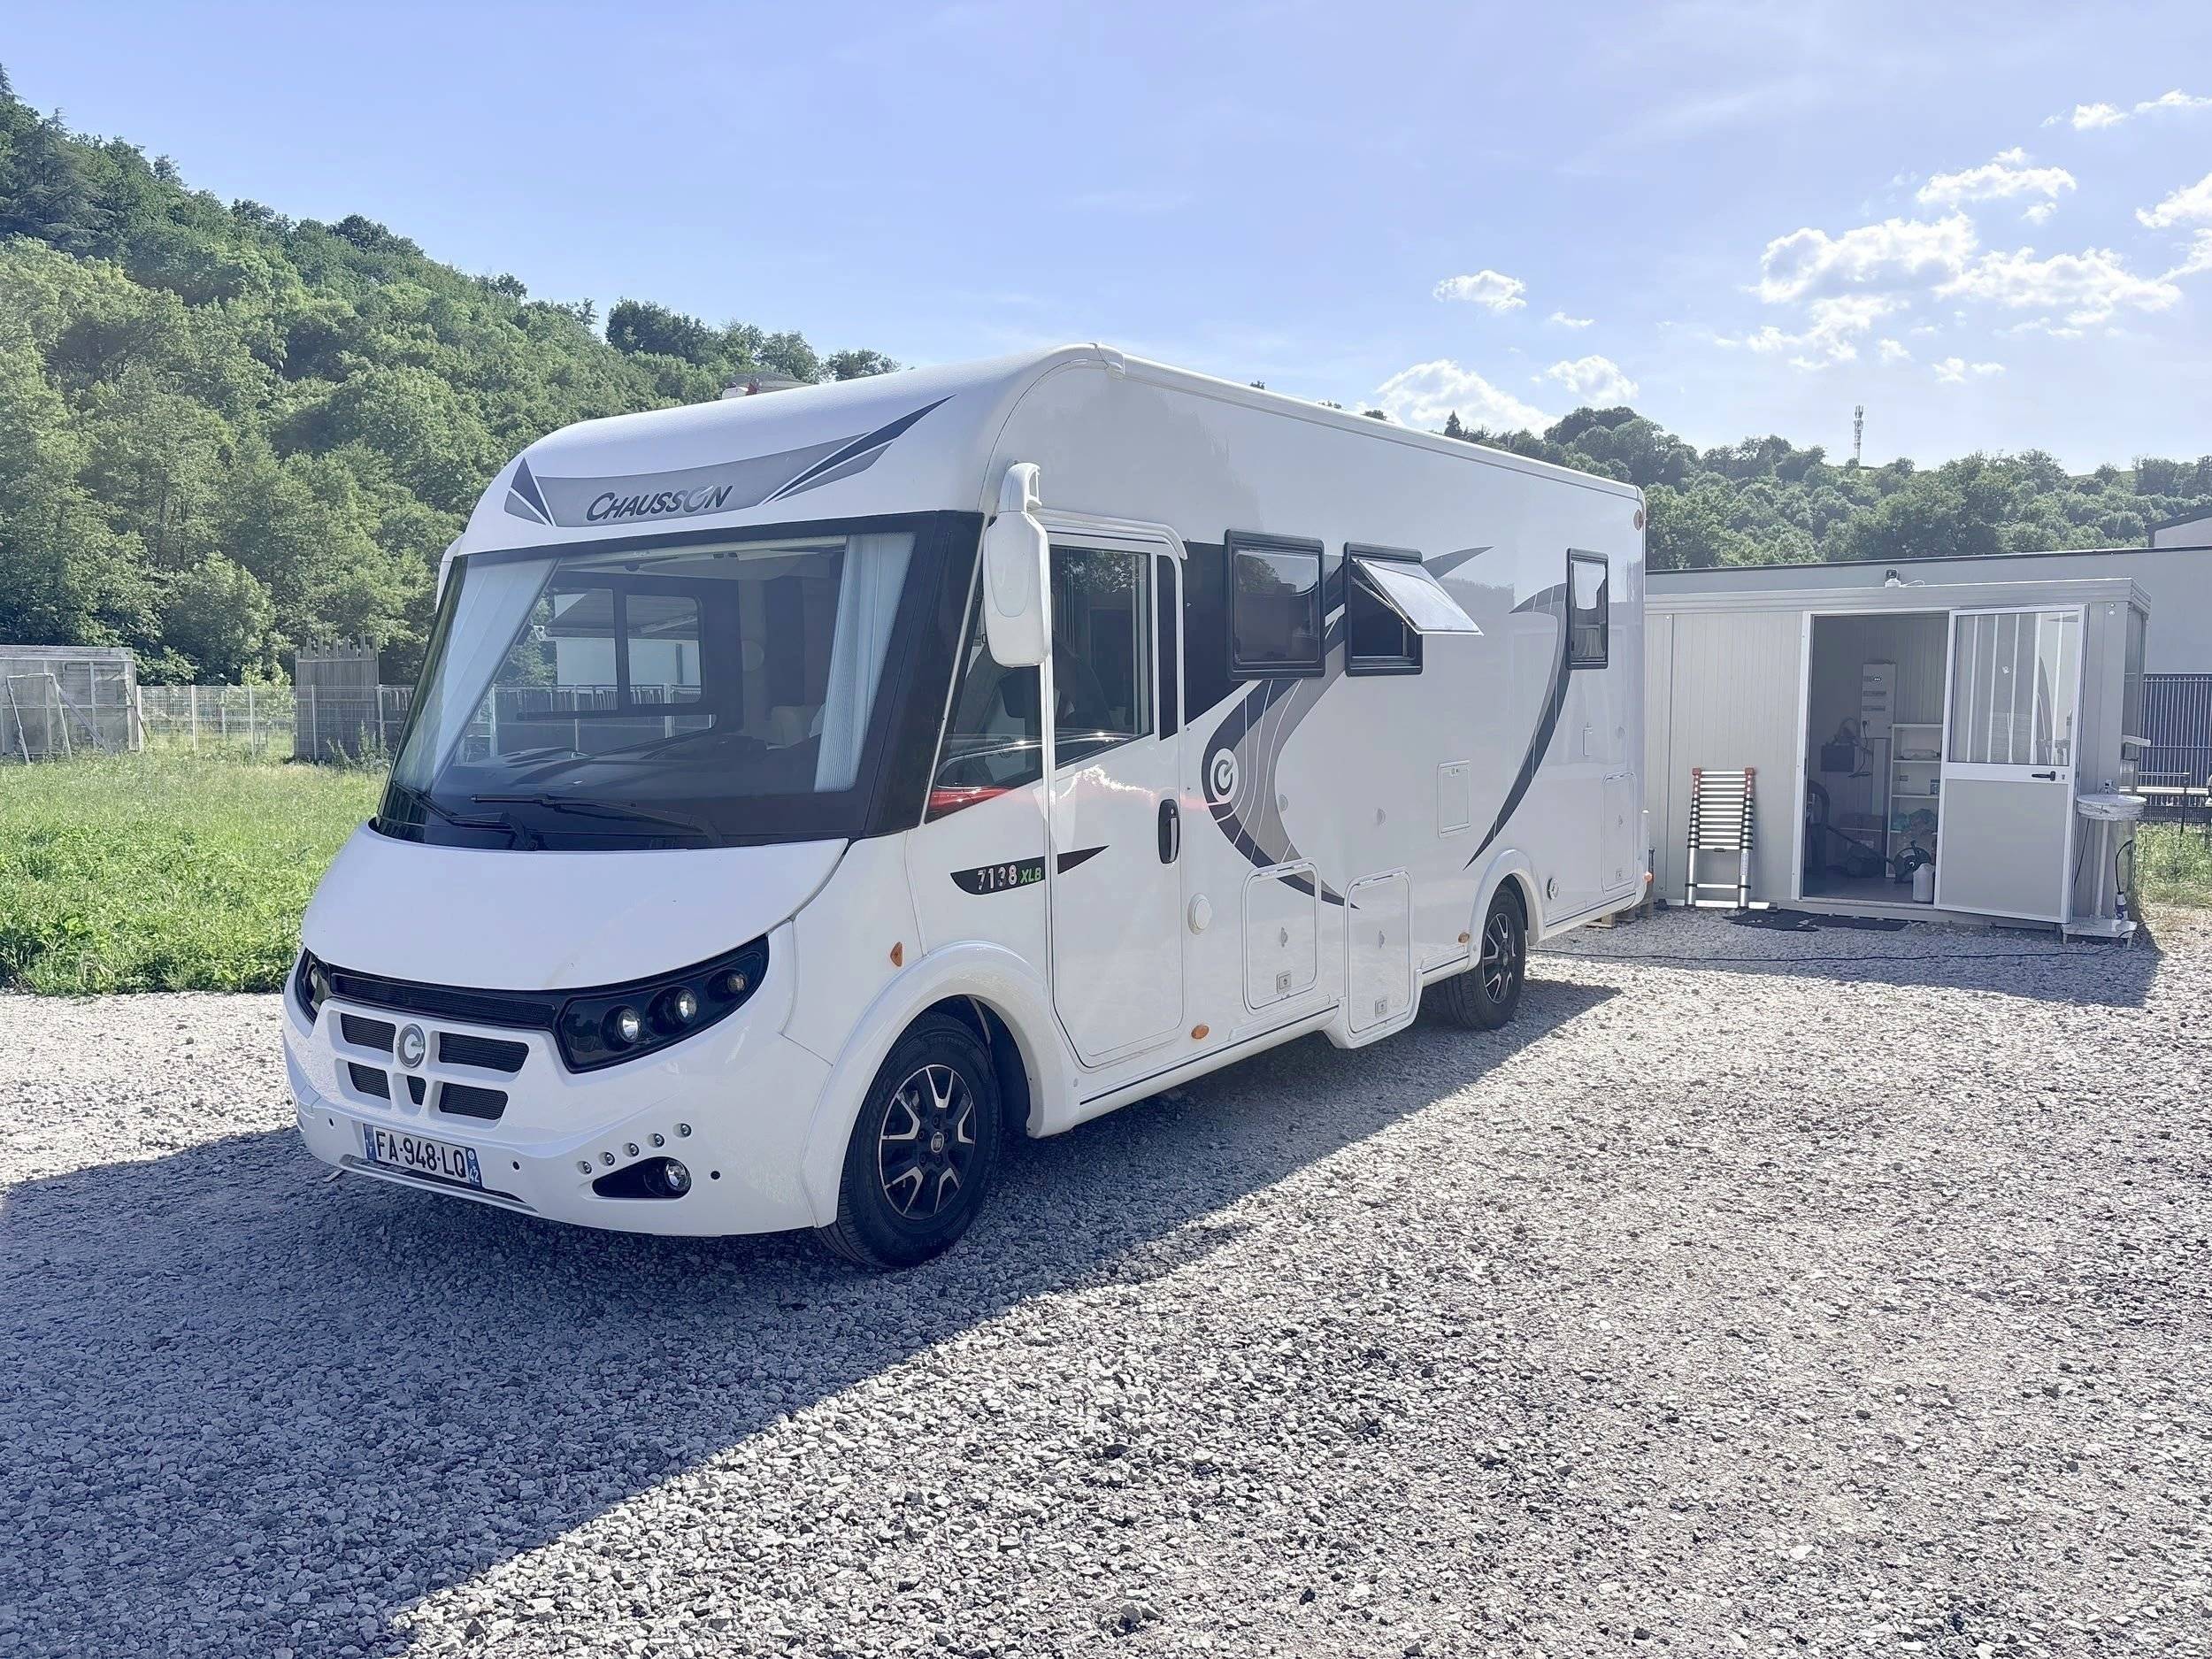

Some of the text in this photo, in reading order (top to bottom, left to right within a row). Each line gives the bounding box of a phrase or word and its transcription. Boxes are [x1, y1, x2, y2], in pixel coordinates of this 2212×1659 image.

[586, 485, 733, 521] CHAUSSON
[977, 864, 1042, 891] 7138 XLB
